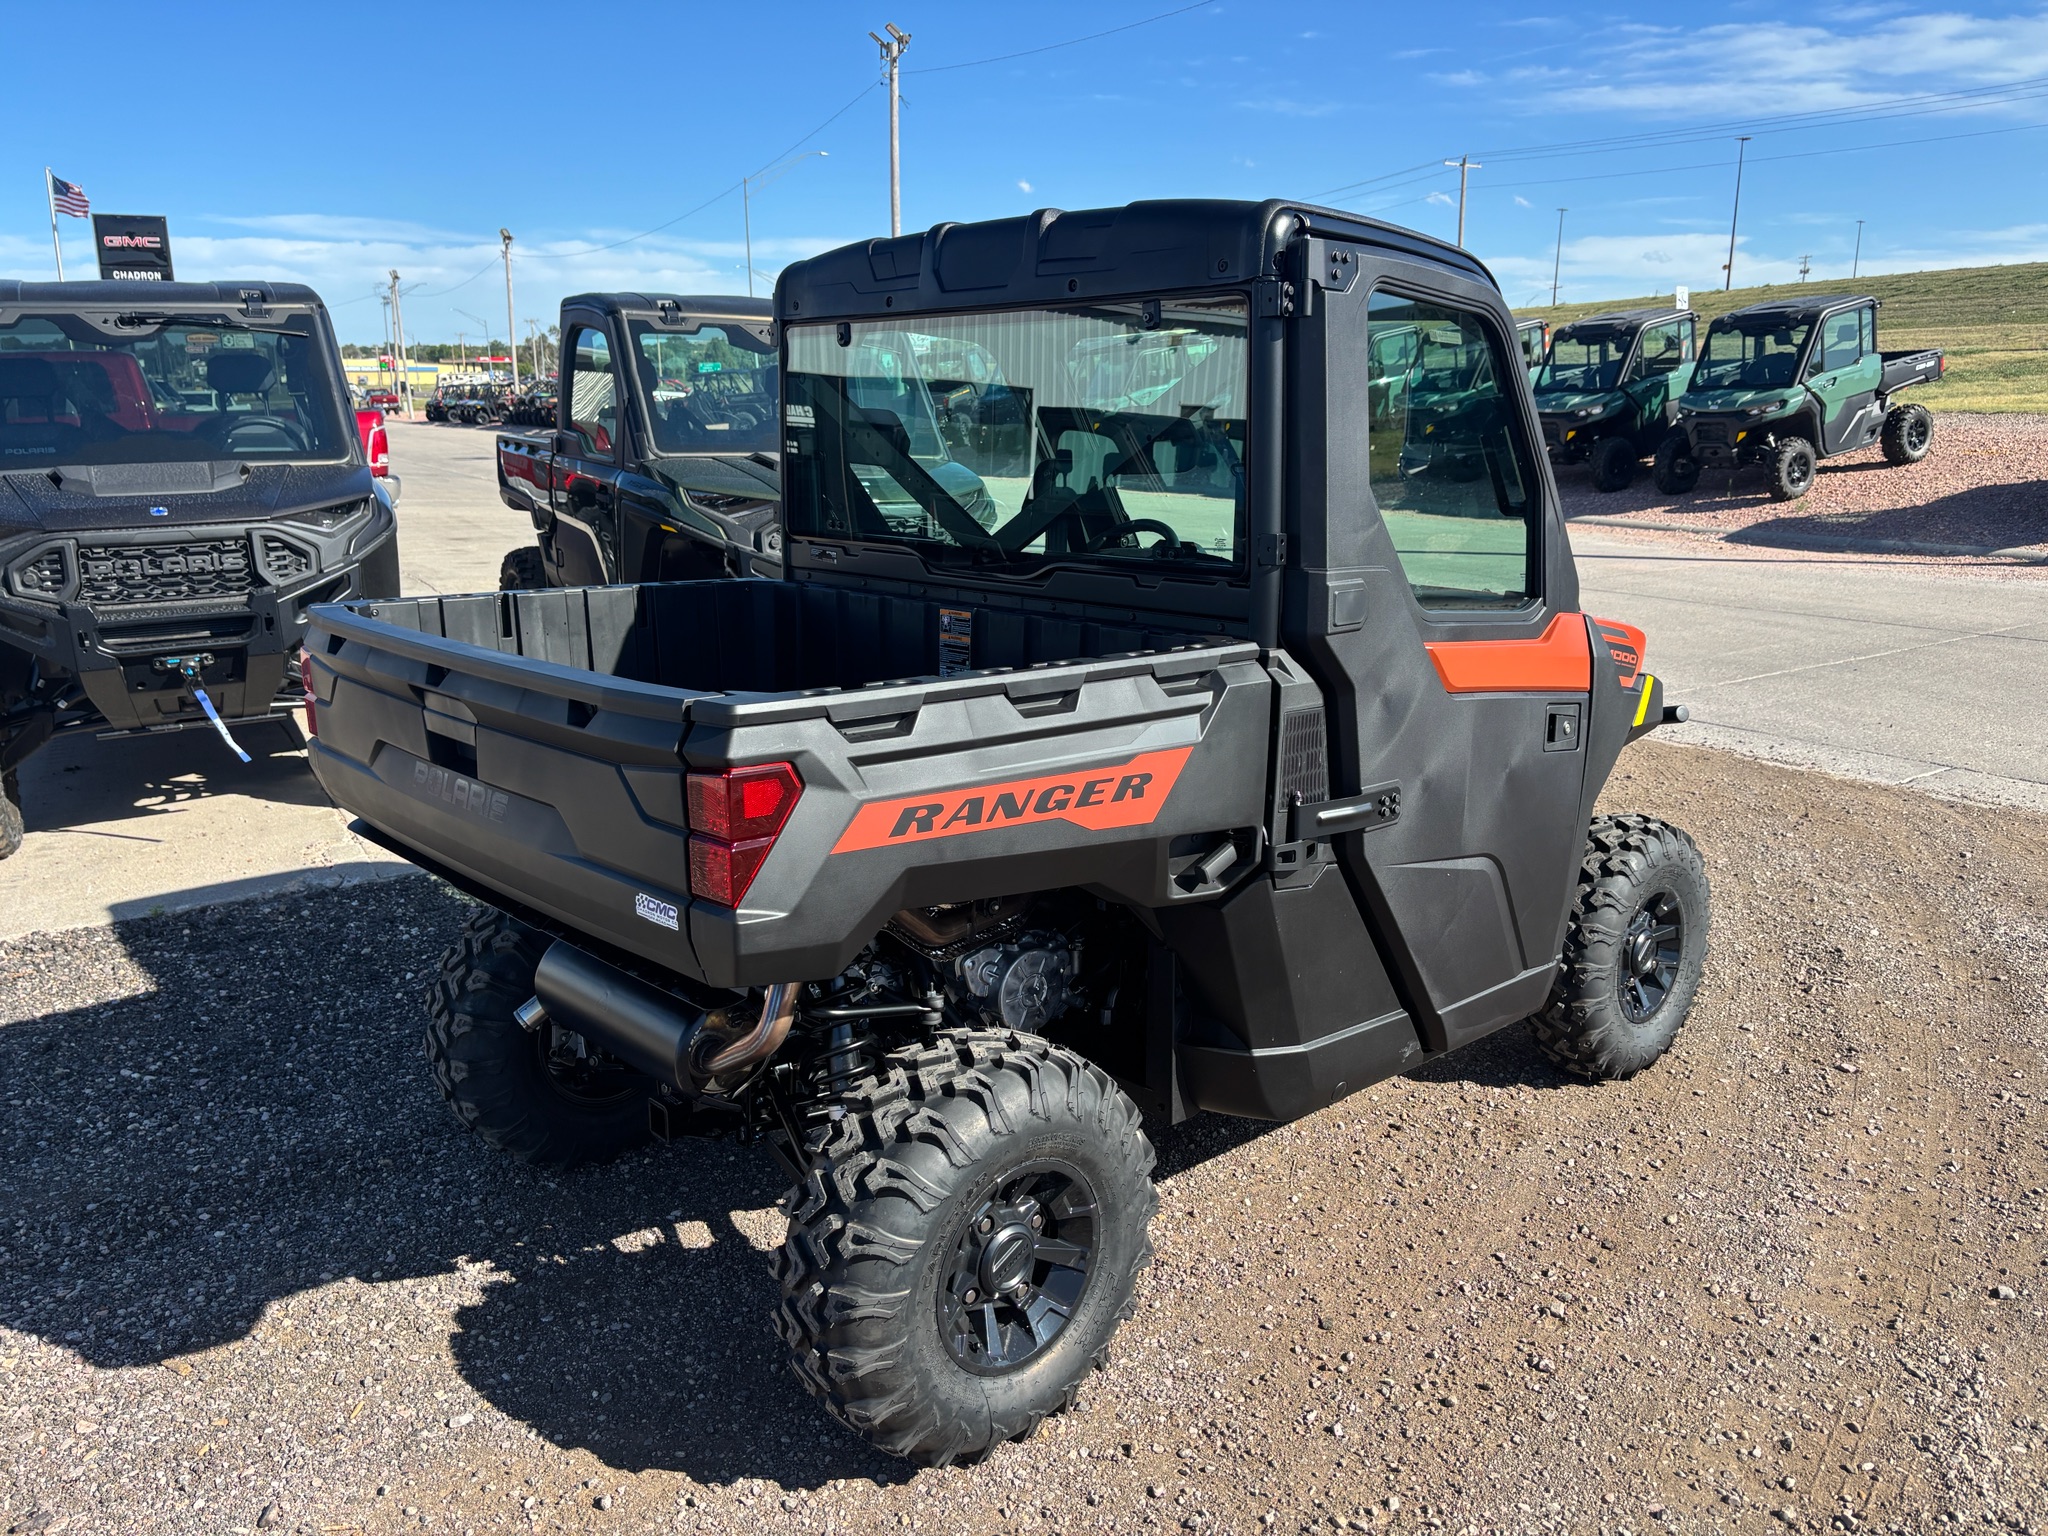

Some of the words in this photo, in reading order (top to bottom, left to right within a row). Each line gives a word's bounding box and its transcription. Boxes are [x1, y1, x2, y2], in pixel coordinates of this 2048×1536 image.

[103, 235, 161, 249] GMC
[113, 270, 162, 281] CHADRON
[4, 446, 57, 455] POLARIS
[87, 552, 247, 578] POLARIS
[412, 760, 509, 824] POLARIS
[888, 772, 1153, 838] RANGER
[646, 899, 677, 921] CMC
